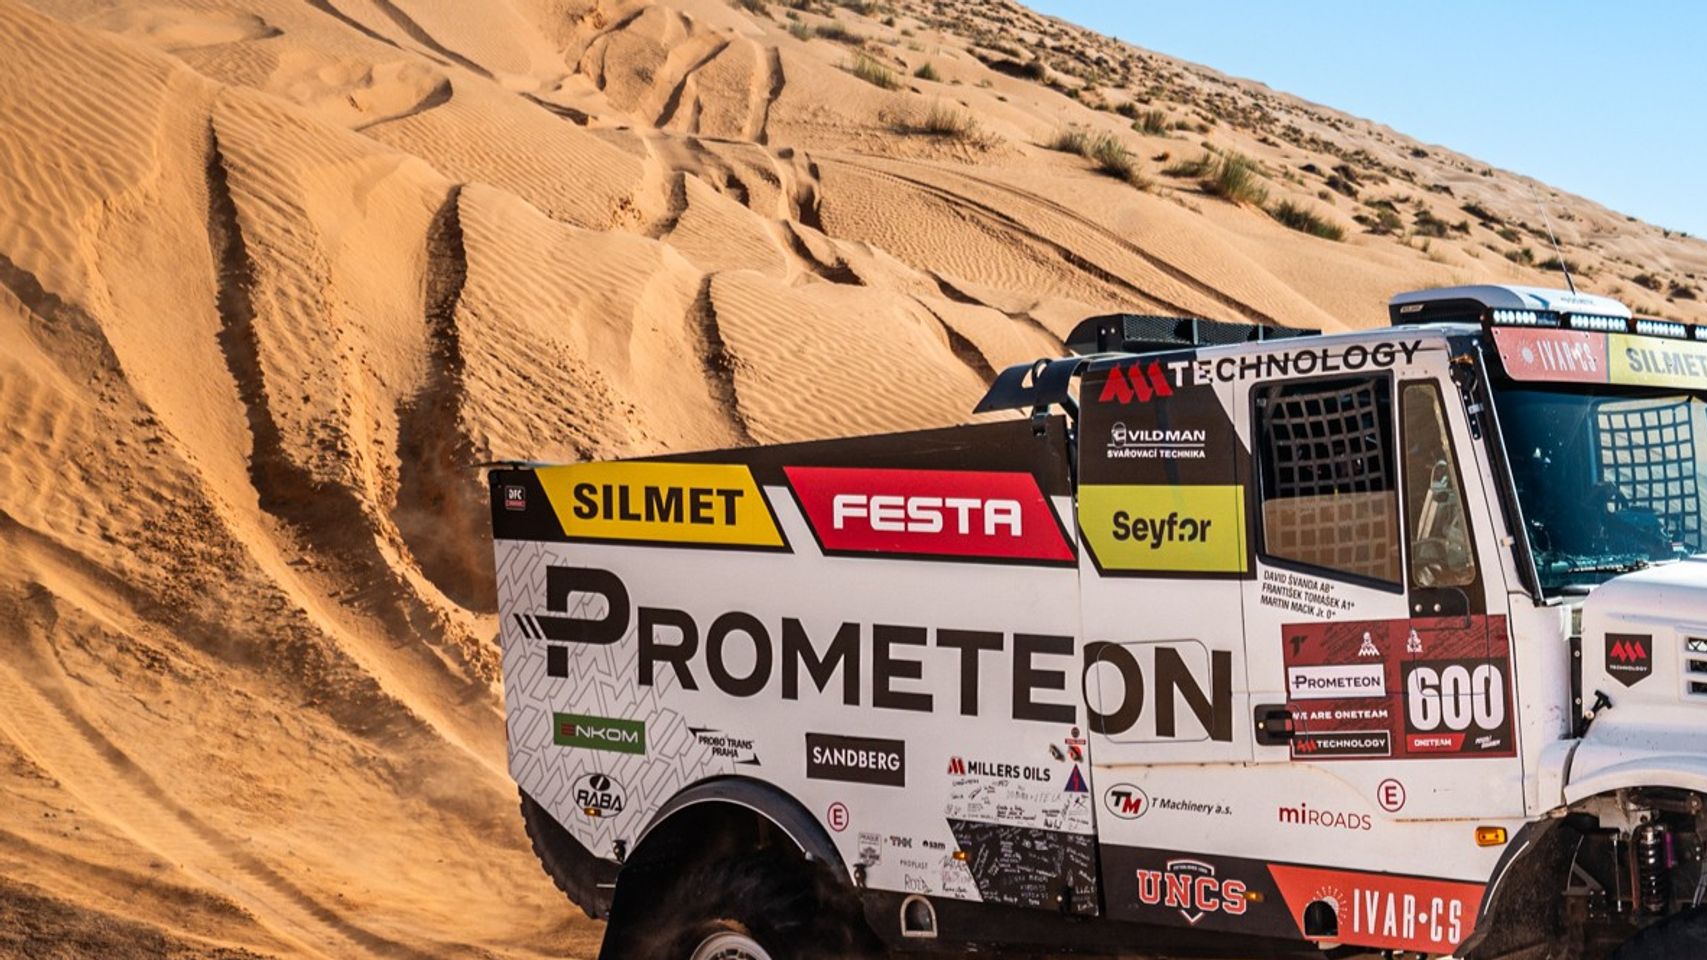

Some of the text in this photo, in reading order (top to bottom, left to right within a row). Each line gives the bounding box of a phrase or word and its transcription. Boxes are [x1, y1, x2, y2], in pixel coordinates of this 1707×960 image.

[1168, 340, 1422, 386] TECHNOLOGY
[1128, 429, 1206, 442] VILDMAN
[1107, 447, 1206, 458] SVAŘOVACÍ TECHNIKA
[572, 481, 744, 526] SILMET
[833, 493, 1022, 537] FESTA
[1112, 511, 1212, 549] Seyfor
[1264, 570, 1286, 584] DAVID
[1288, 573, 1318, 590] ŠVANDA
[1262, 582, 1303, 600] FRANTIŠEK
[1260, 595, 1290, 610] MARTIN
[533, 565, 1233, 742] PROMETEON
[1609, 664, 1648, 672] TECHNOLOGY
[1292, 673, 1381, 689] PROMETEON
[1407, 664, 1504, 731] 600
[1310, 711, 1332, 720] ARE
[1335, 709, 1388, 719] ONETEAM
[699, 735, 753, 750] PROBO TRANS
[1317, 739, 1385, 748] TECHNOLOGY
[712, 747, 739, 758] PRAHA
[813, 746, 900, 771] SANDBERG
[968, 760, 1051, 782] MILLERS OILS
[576, 789, 622, 811] RABA
[1152, 797, 1233, 816] T Machinery a.s.
[1136, 868, 1248, 915] UNCS
